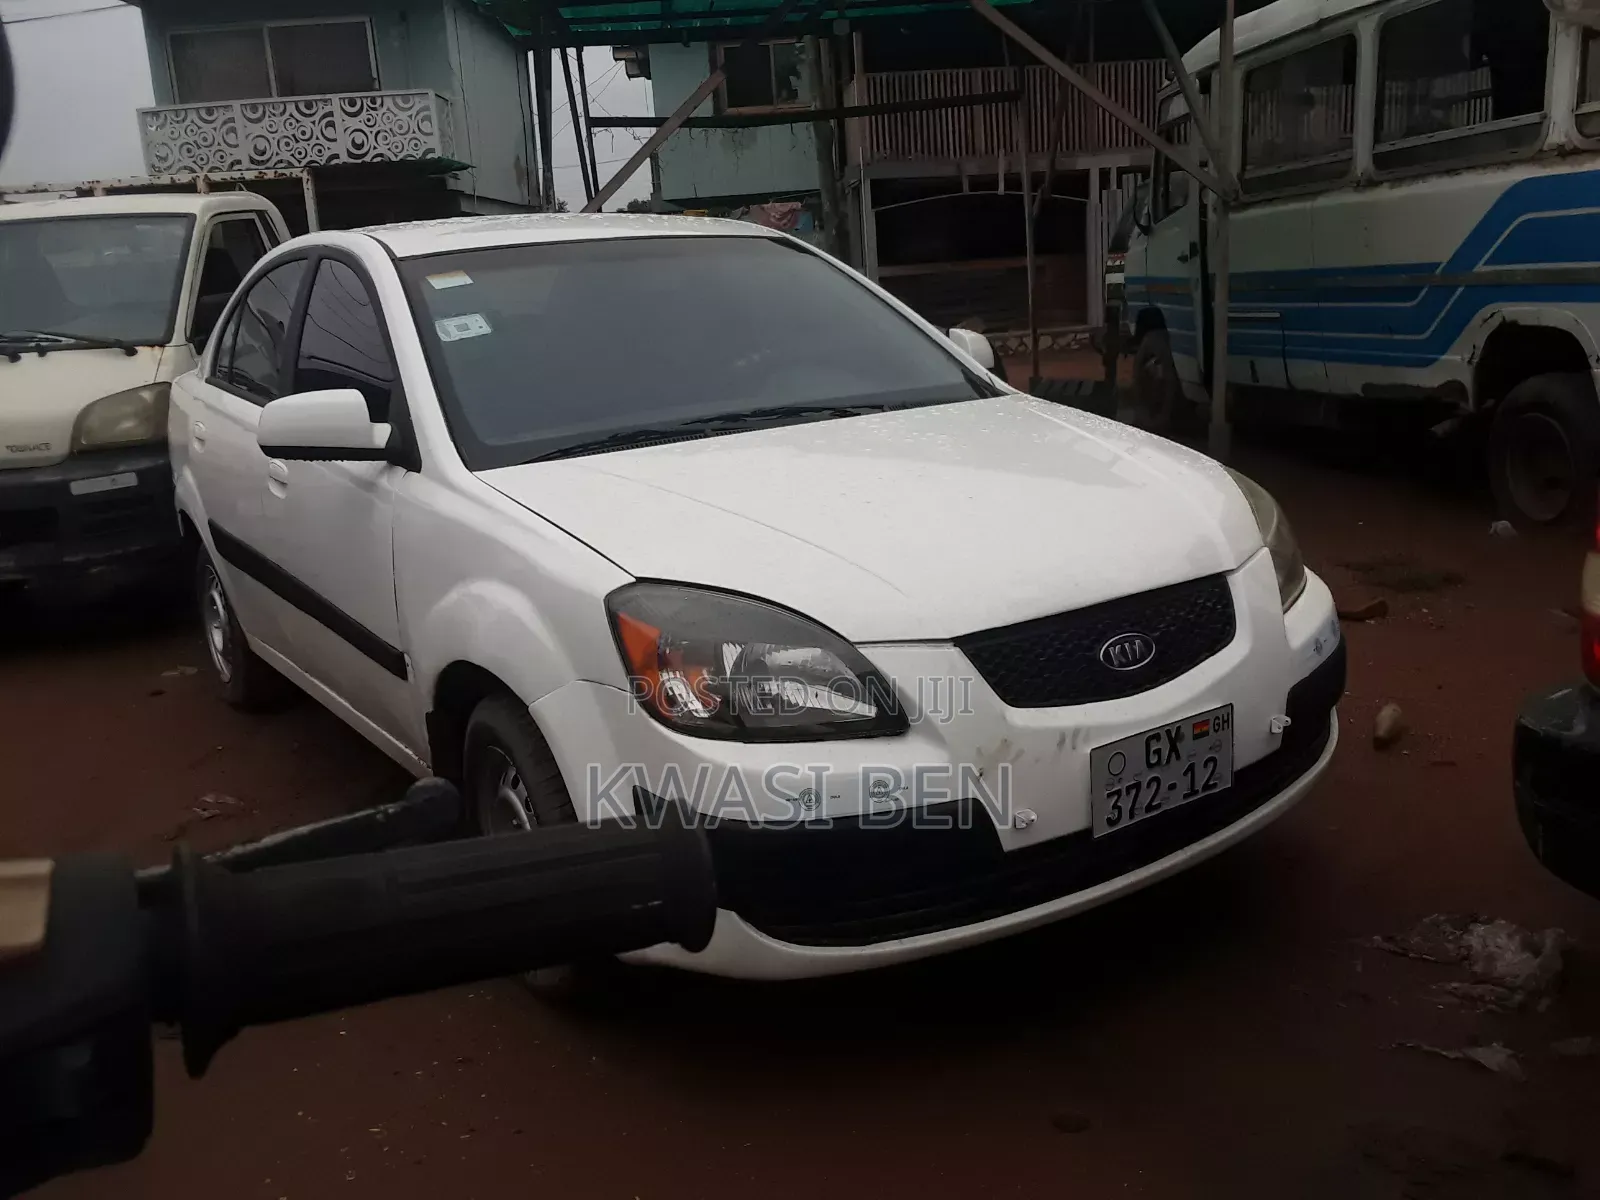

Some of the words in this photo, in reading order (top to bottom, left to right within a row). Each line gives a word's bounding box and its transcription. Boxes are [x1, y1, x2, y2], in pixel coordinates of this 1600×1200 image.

[1108, 639, 1146, 667] KIA
[1144, 725, 1182, 769] GX
[1212, 713, 1231, 732] GH
[1106, 756, 1218, 827] 372-12
